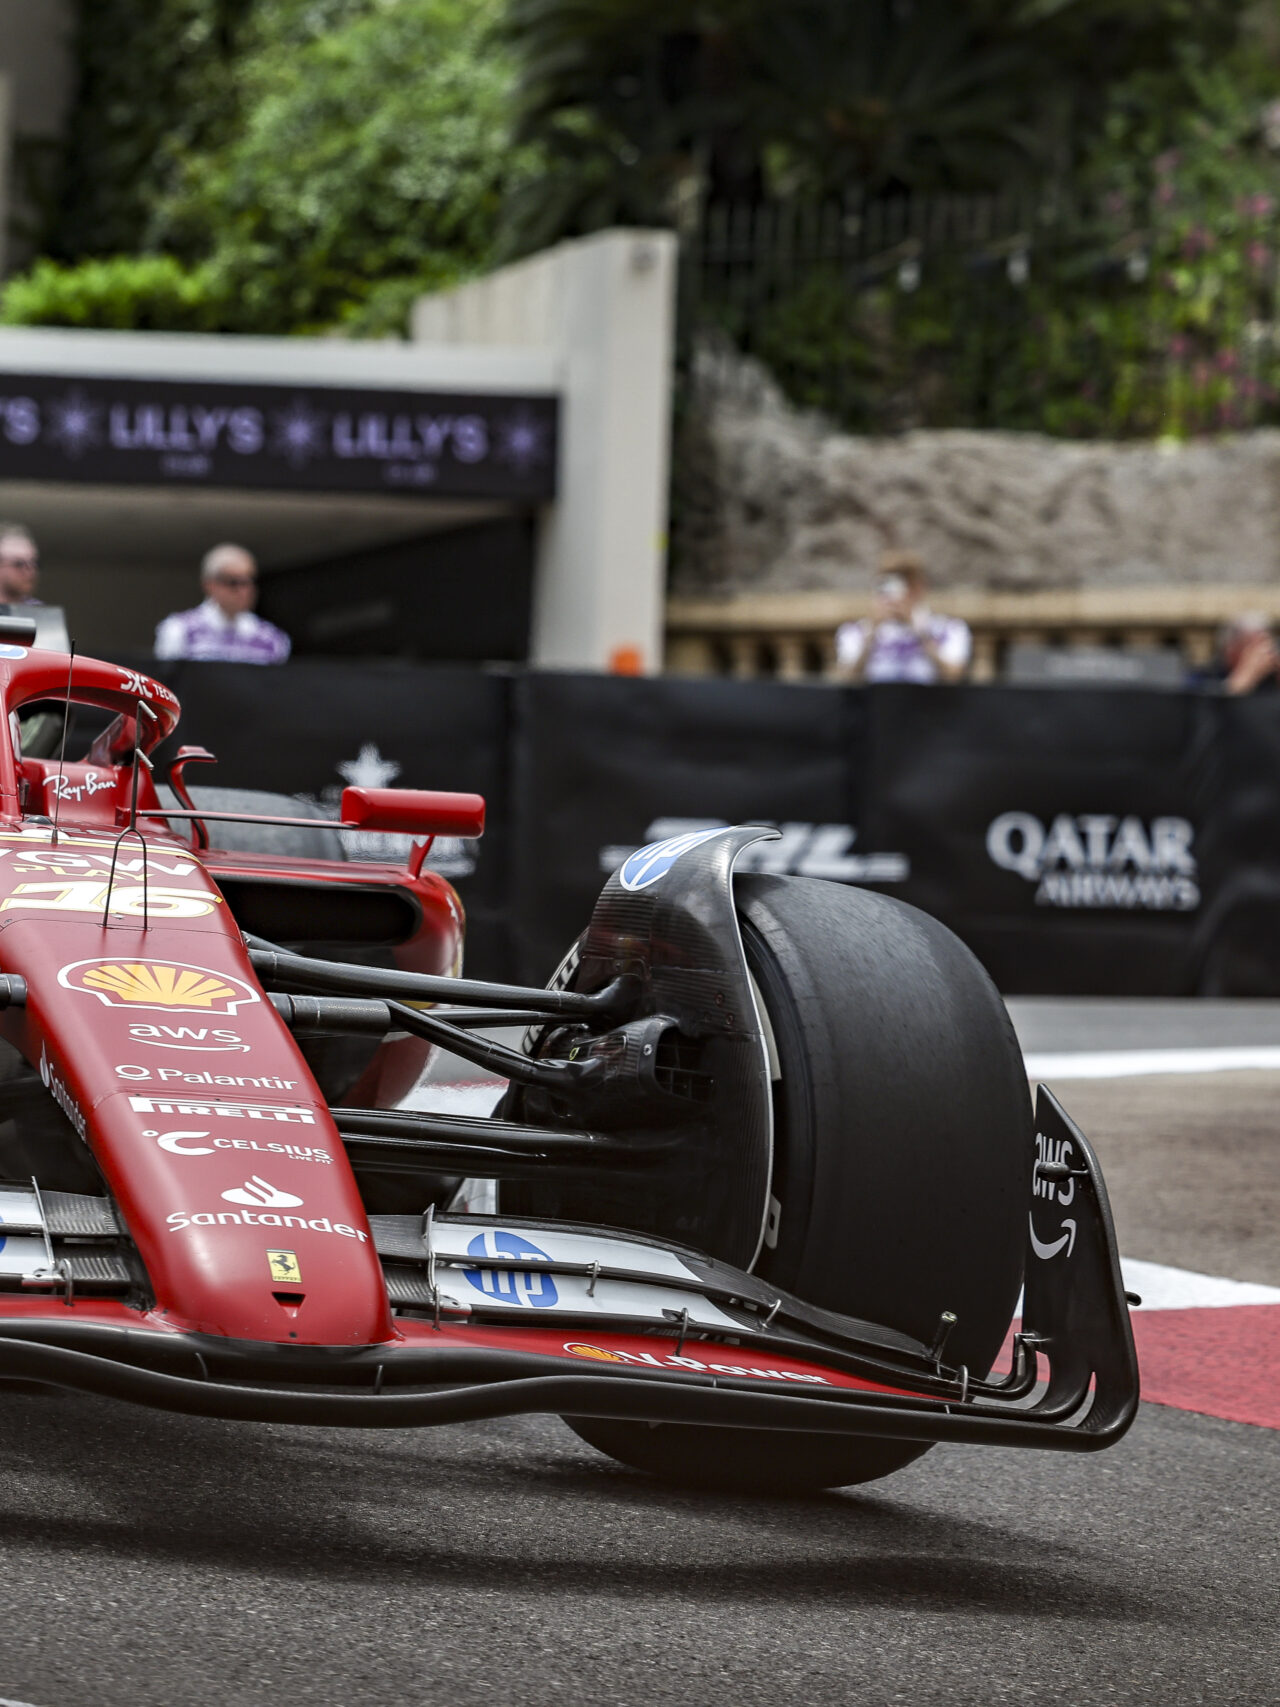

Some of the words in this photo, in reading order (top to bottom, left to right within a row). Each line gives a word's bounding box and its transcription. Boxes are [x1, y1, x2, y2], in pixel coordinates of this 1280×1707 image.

[42, 772, 116, 801] Ray-Ban
[986, 811, 1198, 881] QATAR
[11, 862, 156, 882] PLAY
[0, 880, 222, 918] 16
[1035, 874, 1200, 911] AIRWAYS
[128, 1023, 242, 1043] aws
[157, 1067, 298, 1090] Palantir
[128, 1096, 316, 1124] PIRELLI
[213, 1138, 331, 1160] CELSIUS
[288, 1154, 313, 1162] LIVE
[1032, 1132, 1075, 1206] aws
[166, 1209, 369, 1243] Santander
[476, 1231, 552, 1307] hp
[613, 1350, 833, 1385] V-Power
